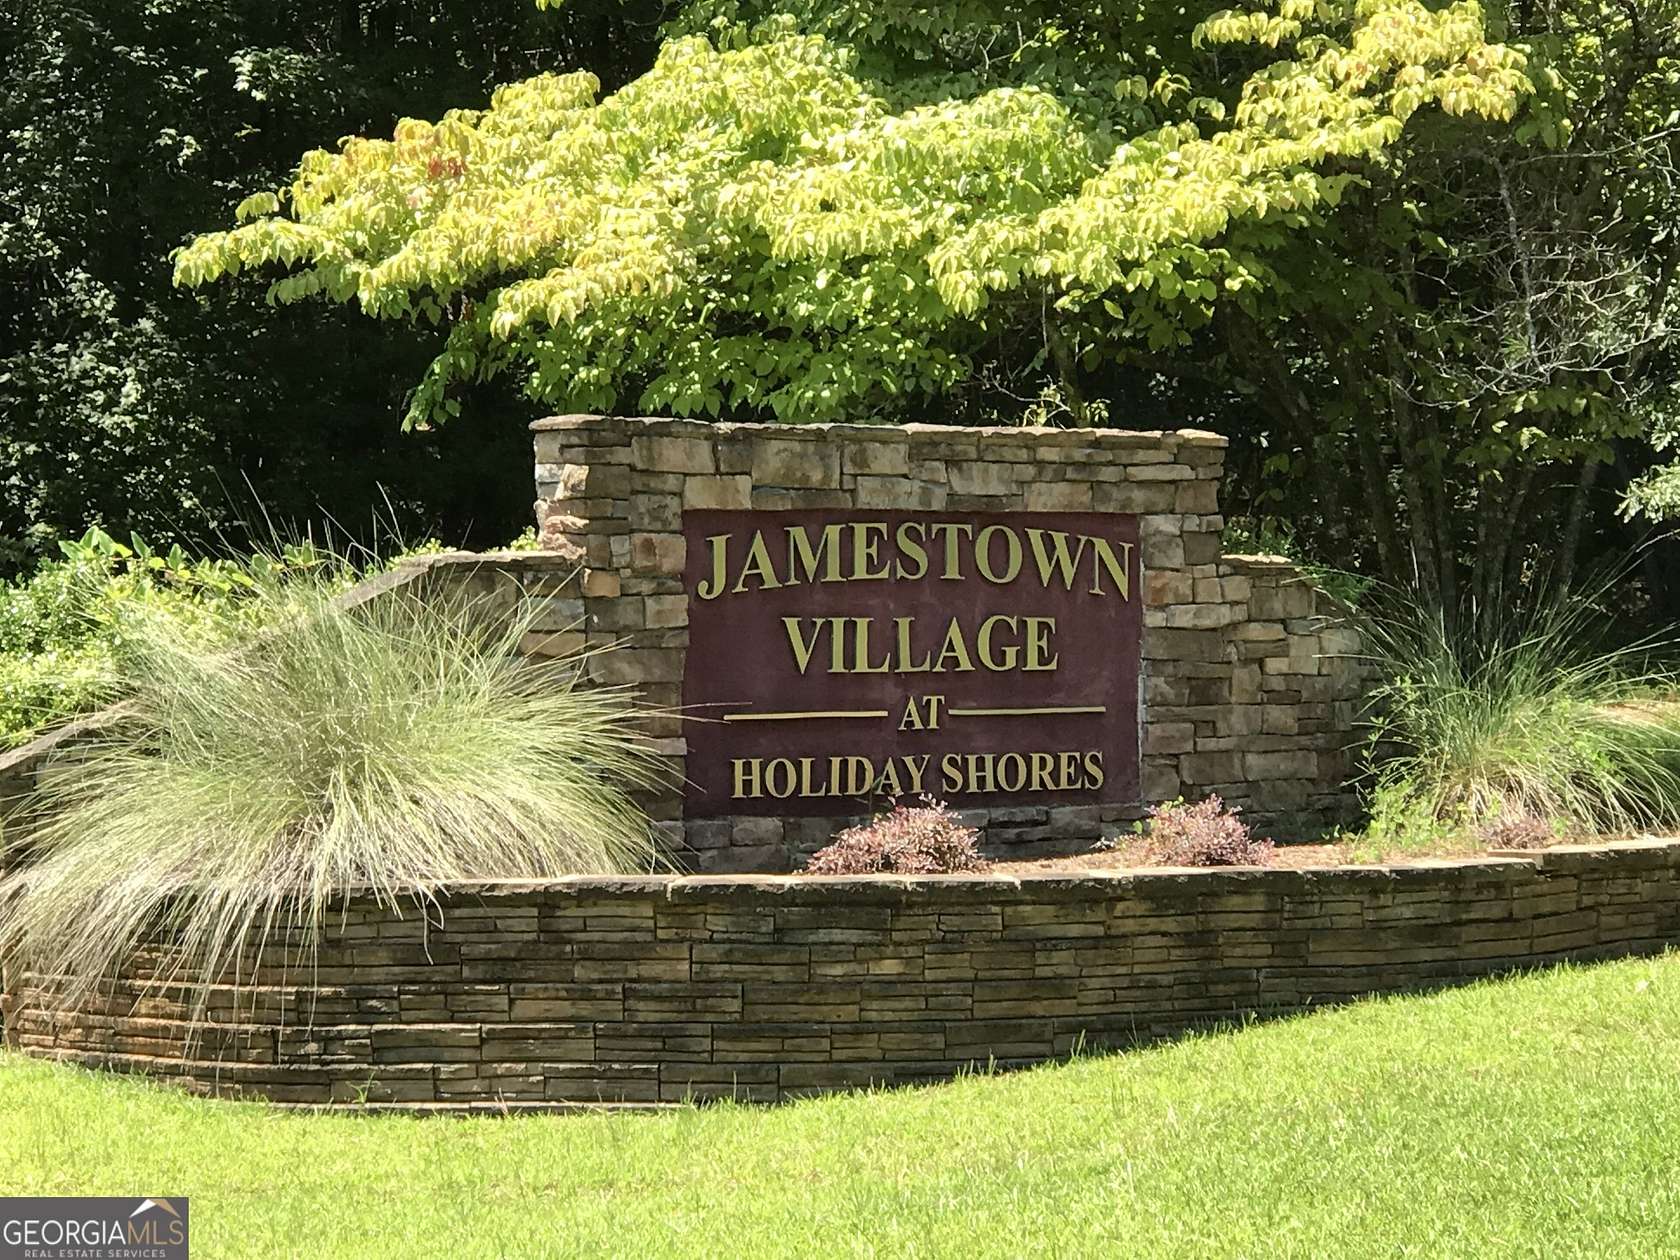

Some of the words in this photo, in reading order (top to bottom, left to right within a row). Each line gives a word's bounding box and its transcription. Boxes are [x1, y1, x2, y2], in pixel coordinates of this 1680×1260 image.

[698, 522, 1134, 602] JAMESTOWN
[781, 615, 1058, 675] VILLAGE
[898, 695, 945, 731] AT
[731, 754, 932, 799] HOLIDAY
[941, 751, 1104, 795] SHORES
